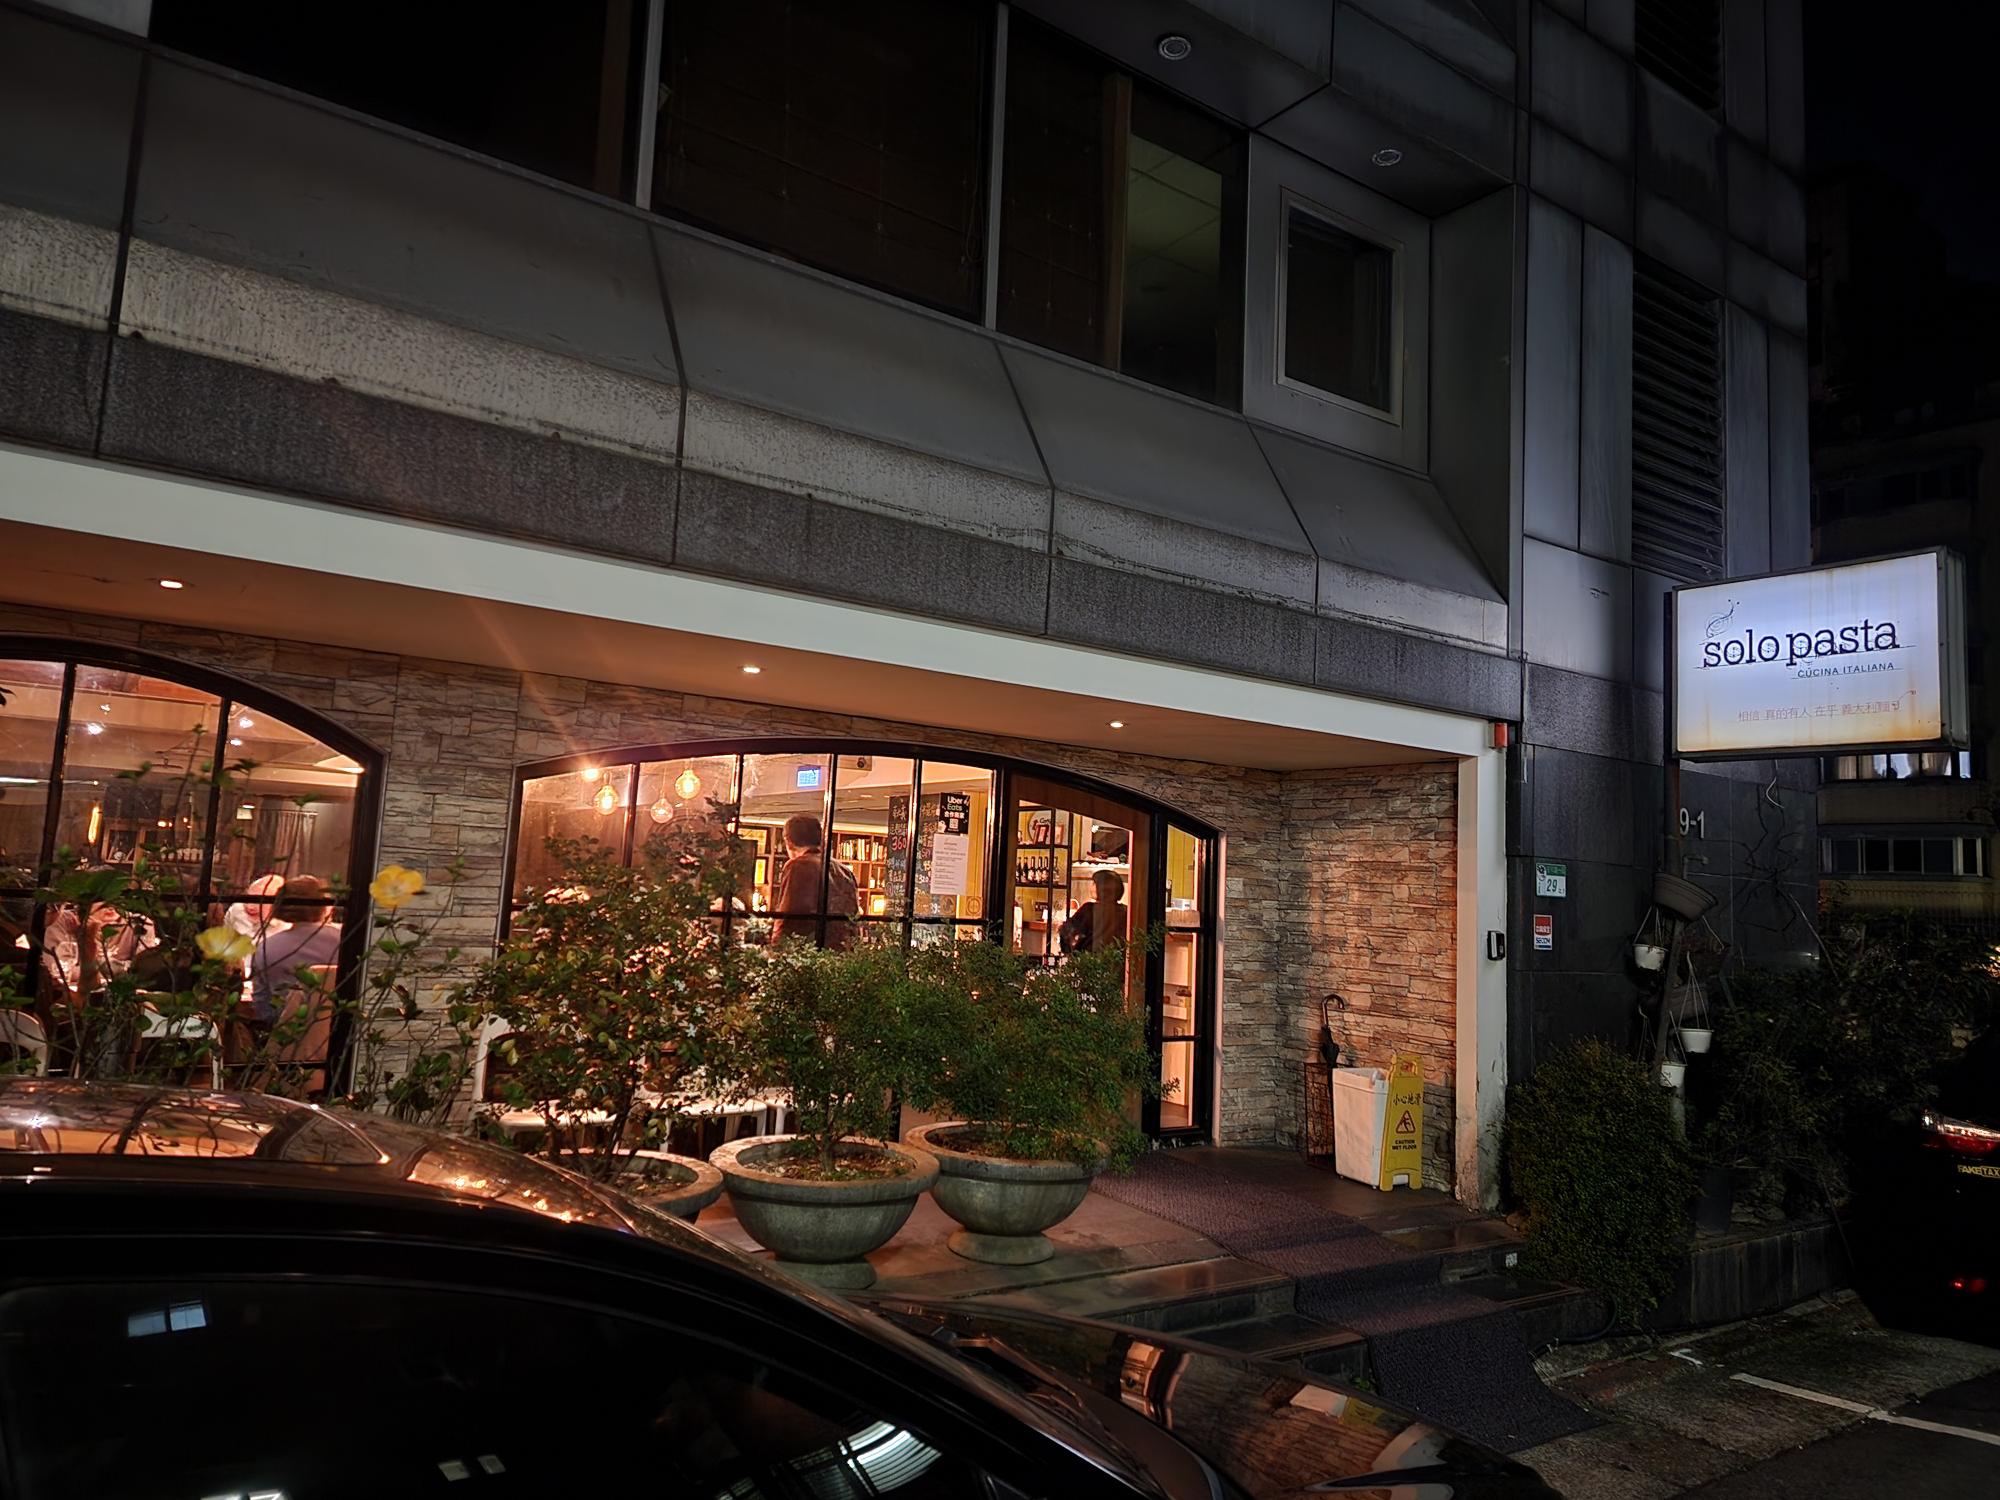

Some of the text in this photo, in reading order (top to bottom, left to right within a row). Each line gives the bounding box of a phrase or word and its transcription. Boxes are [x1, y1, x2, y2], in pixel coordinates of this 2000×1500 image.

[1703, 619, 1901, 668] solo pasta
[1797, 662, 1895, 678] CUCINA ITALIANA
[947, 796, 963, 805] Uber
[947, 804, 963, 812] Eats
[1546, 878, 1558, 893] 29
